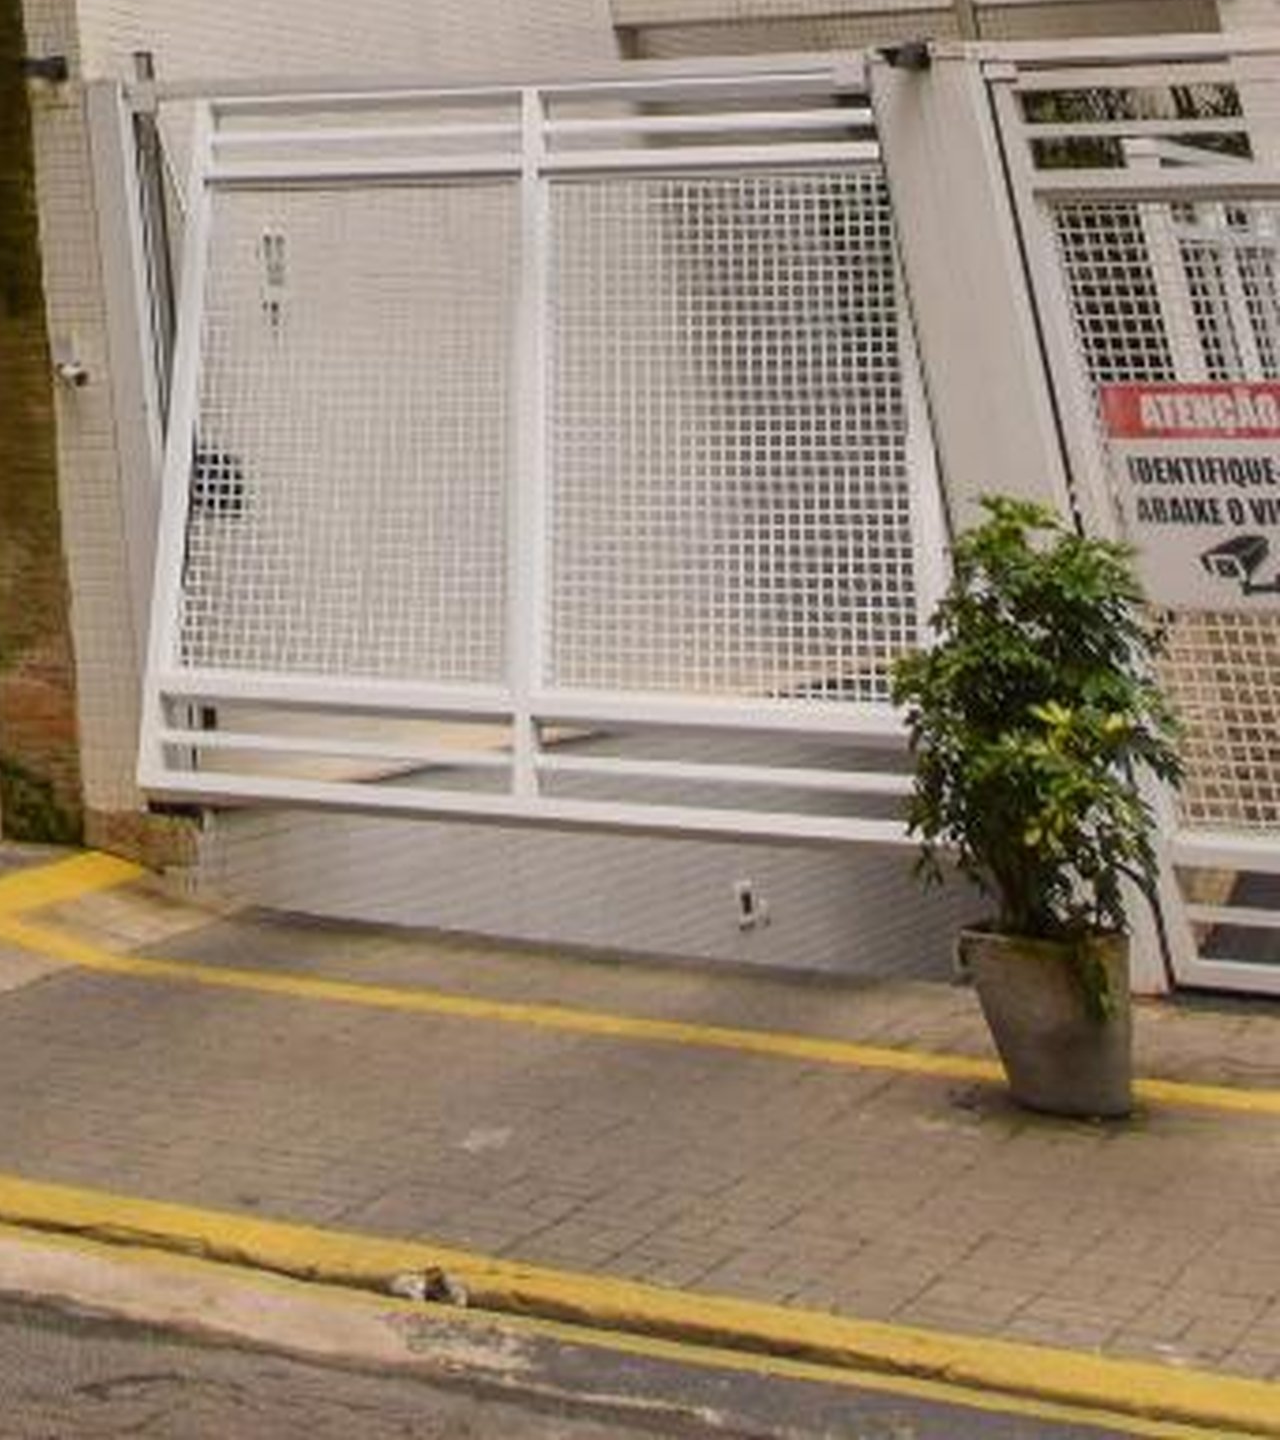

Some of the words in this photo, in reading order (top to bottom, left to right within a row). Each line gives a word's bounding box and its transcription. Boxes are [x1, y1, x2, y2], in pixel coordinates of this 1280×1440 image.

[1139, 386, 1277, 437] ATENÇÃO
[1137, 496, 1223, 525] ABAIXE
[1226, 497, 1244, 526] O
[1248, 496, 1280, 526] VI
